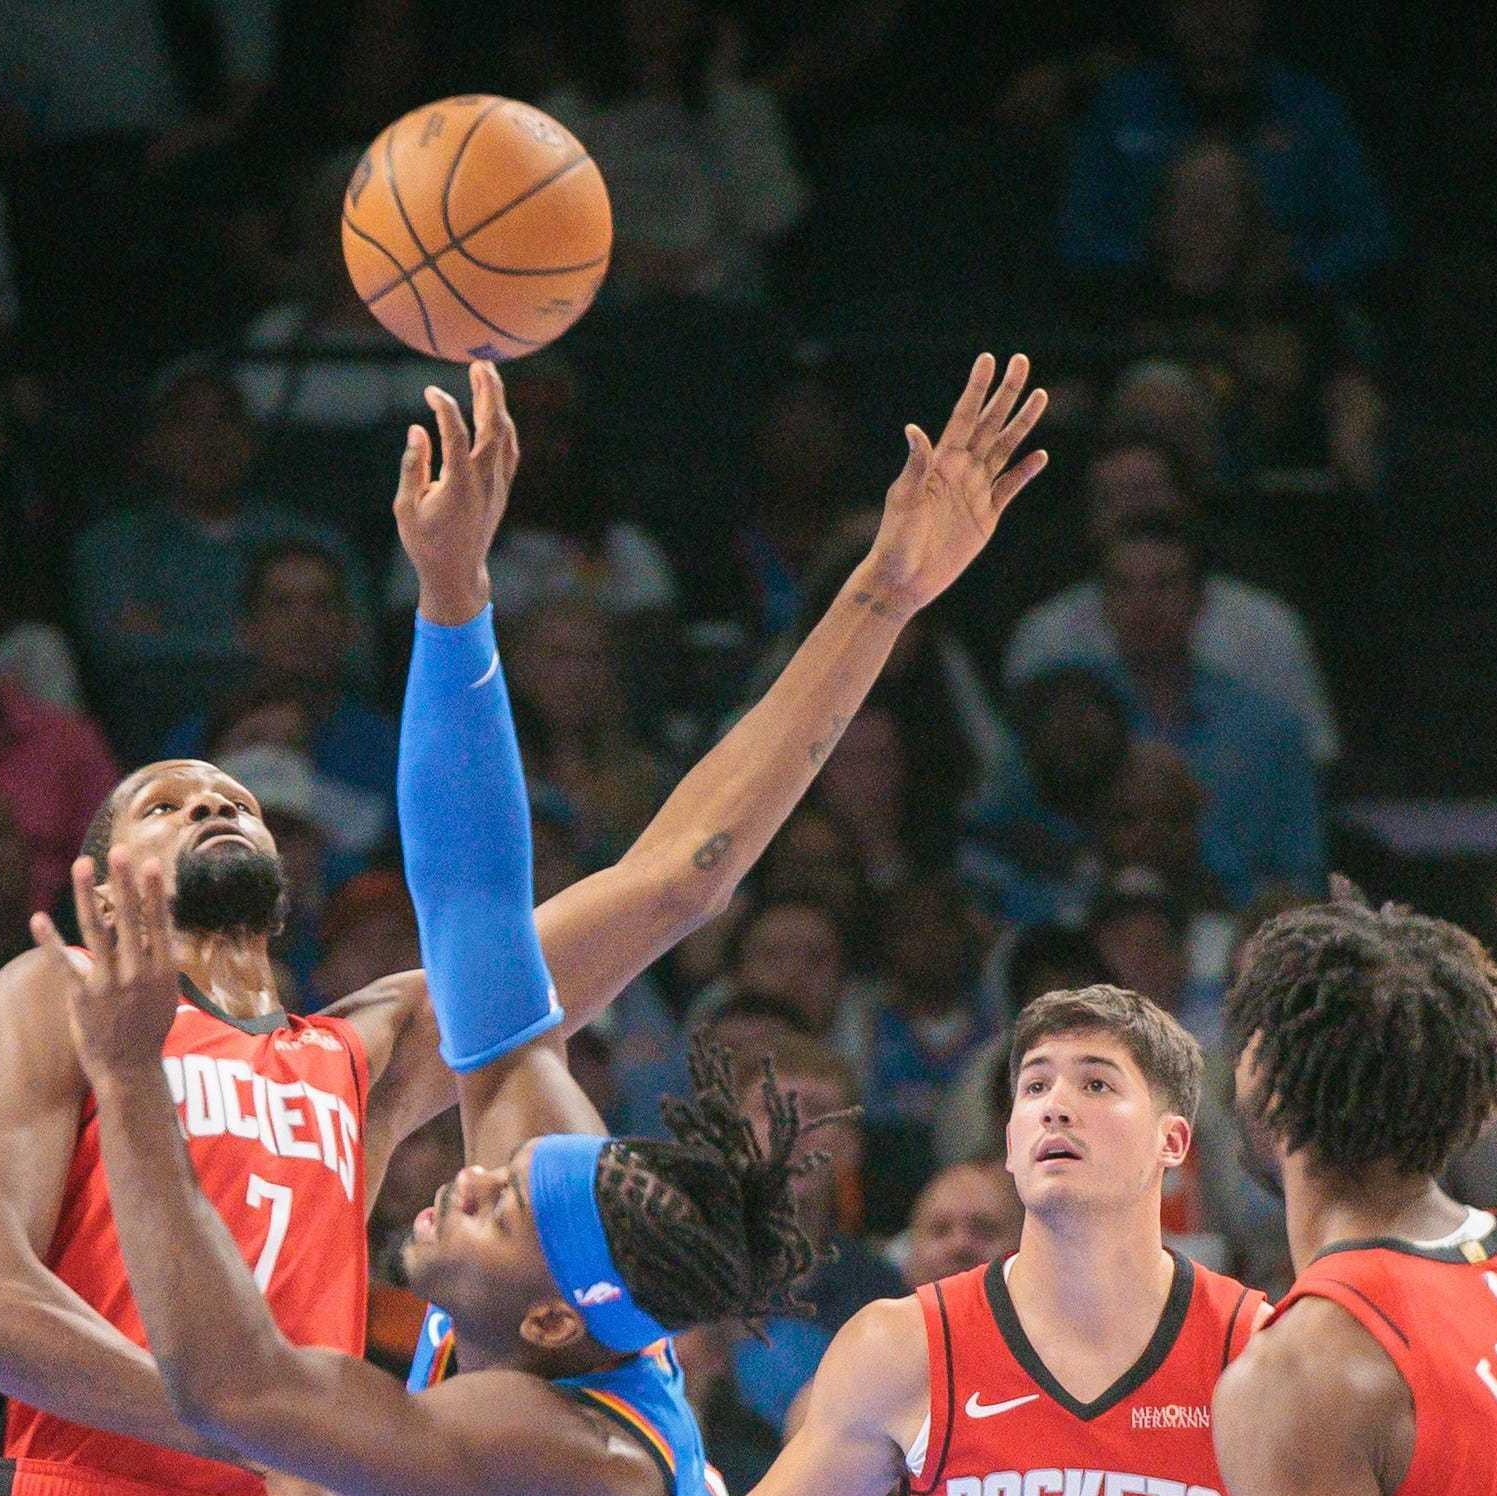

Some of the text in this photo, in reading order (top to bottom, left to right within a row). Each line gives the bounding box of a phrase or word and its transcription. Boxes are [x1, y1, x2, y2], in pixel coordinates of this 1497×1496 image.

[246, 1173, 293, 1294] 7
[1131, 1404, 1210, 1418] MEMORIAL
[1131, 1417, 1210, 1428] HERMANN
